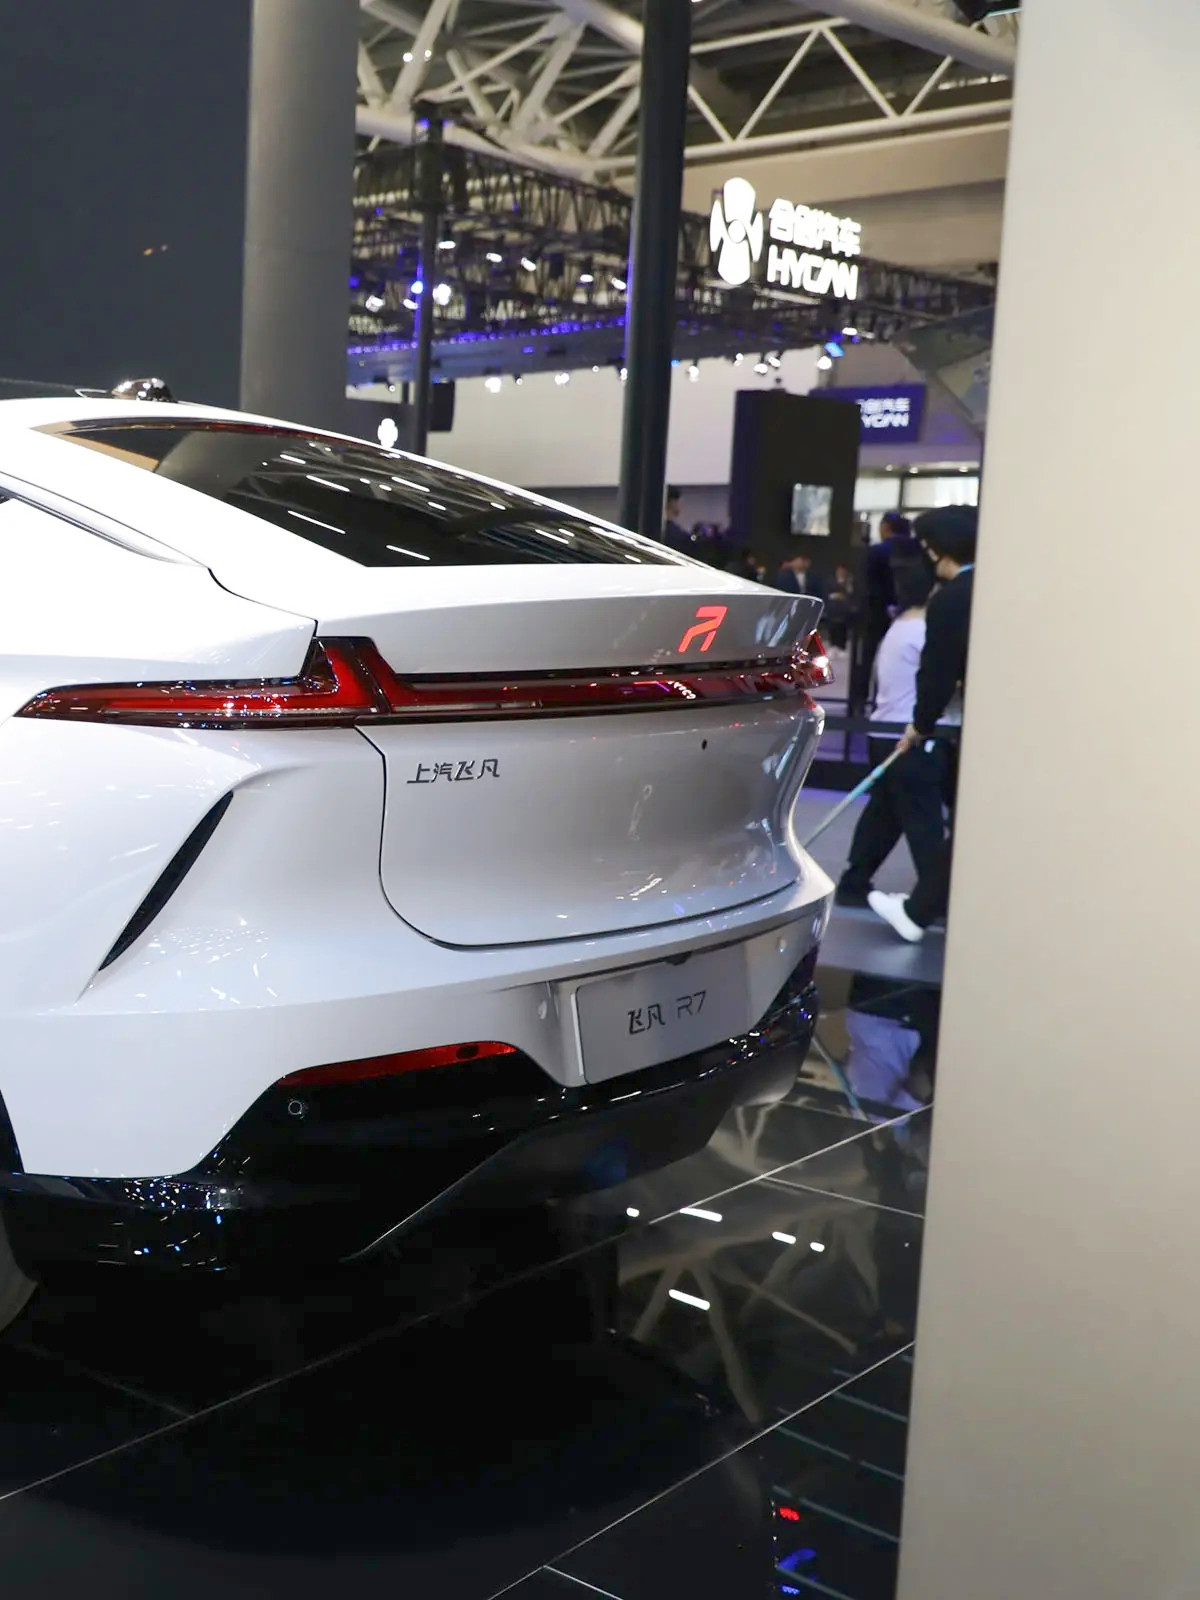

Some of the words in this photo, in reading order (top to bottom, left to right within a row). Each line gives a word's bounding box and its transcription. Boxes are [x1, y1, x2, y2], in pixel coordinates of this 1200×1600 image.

[767, 245, 858, 300] HYCAN
[861, 413, 909, 428] YCAN
[406, 758, 500, 784] 上汽飞凡
[628, 1003, 666, 1035] 飞凡
[676, 989, 706, 1019] R7
